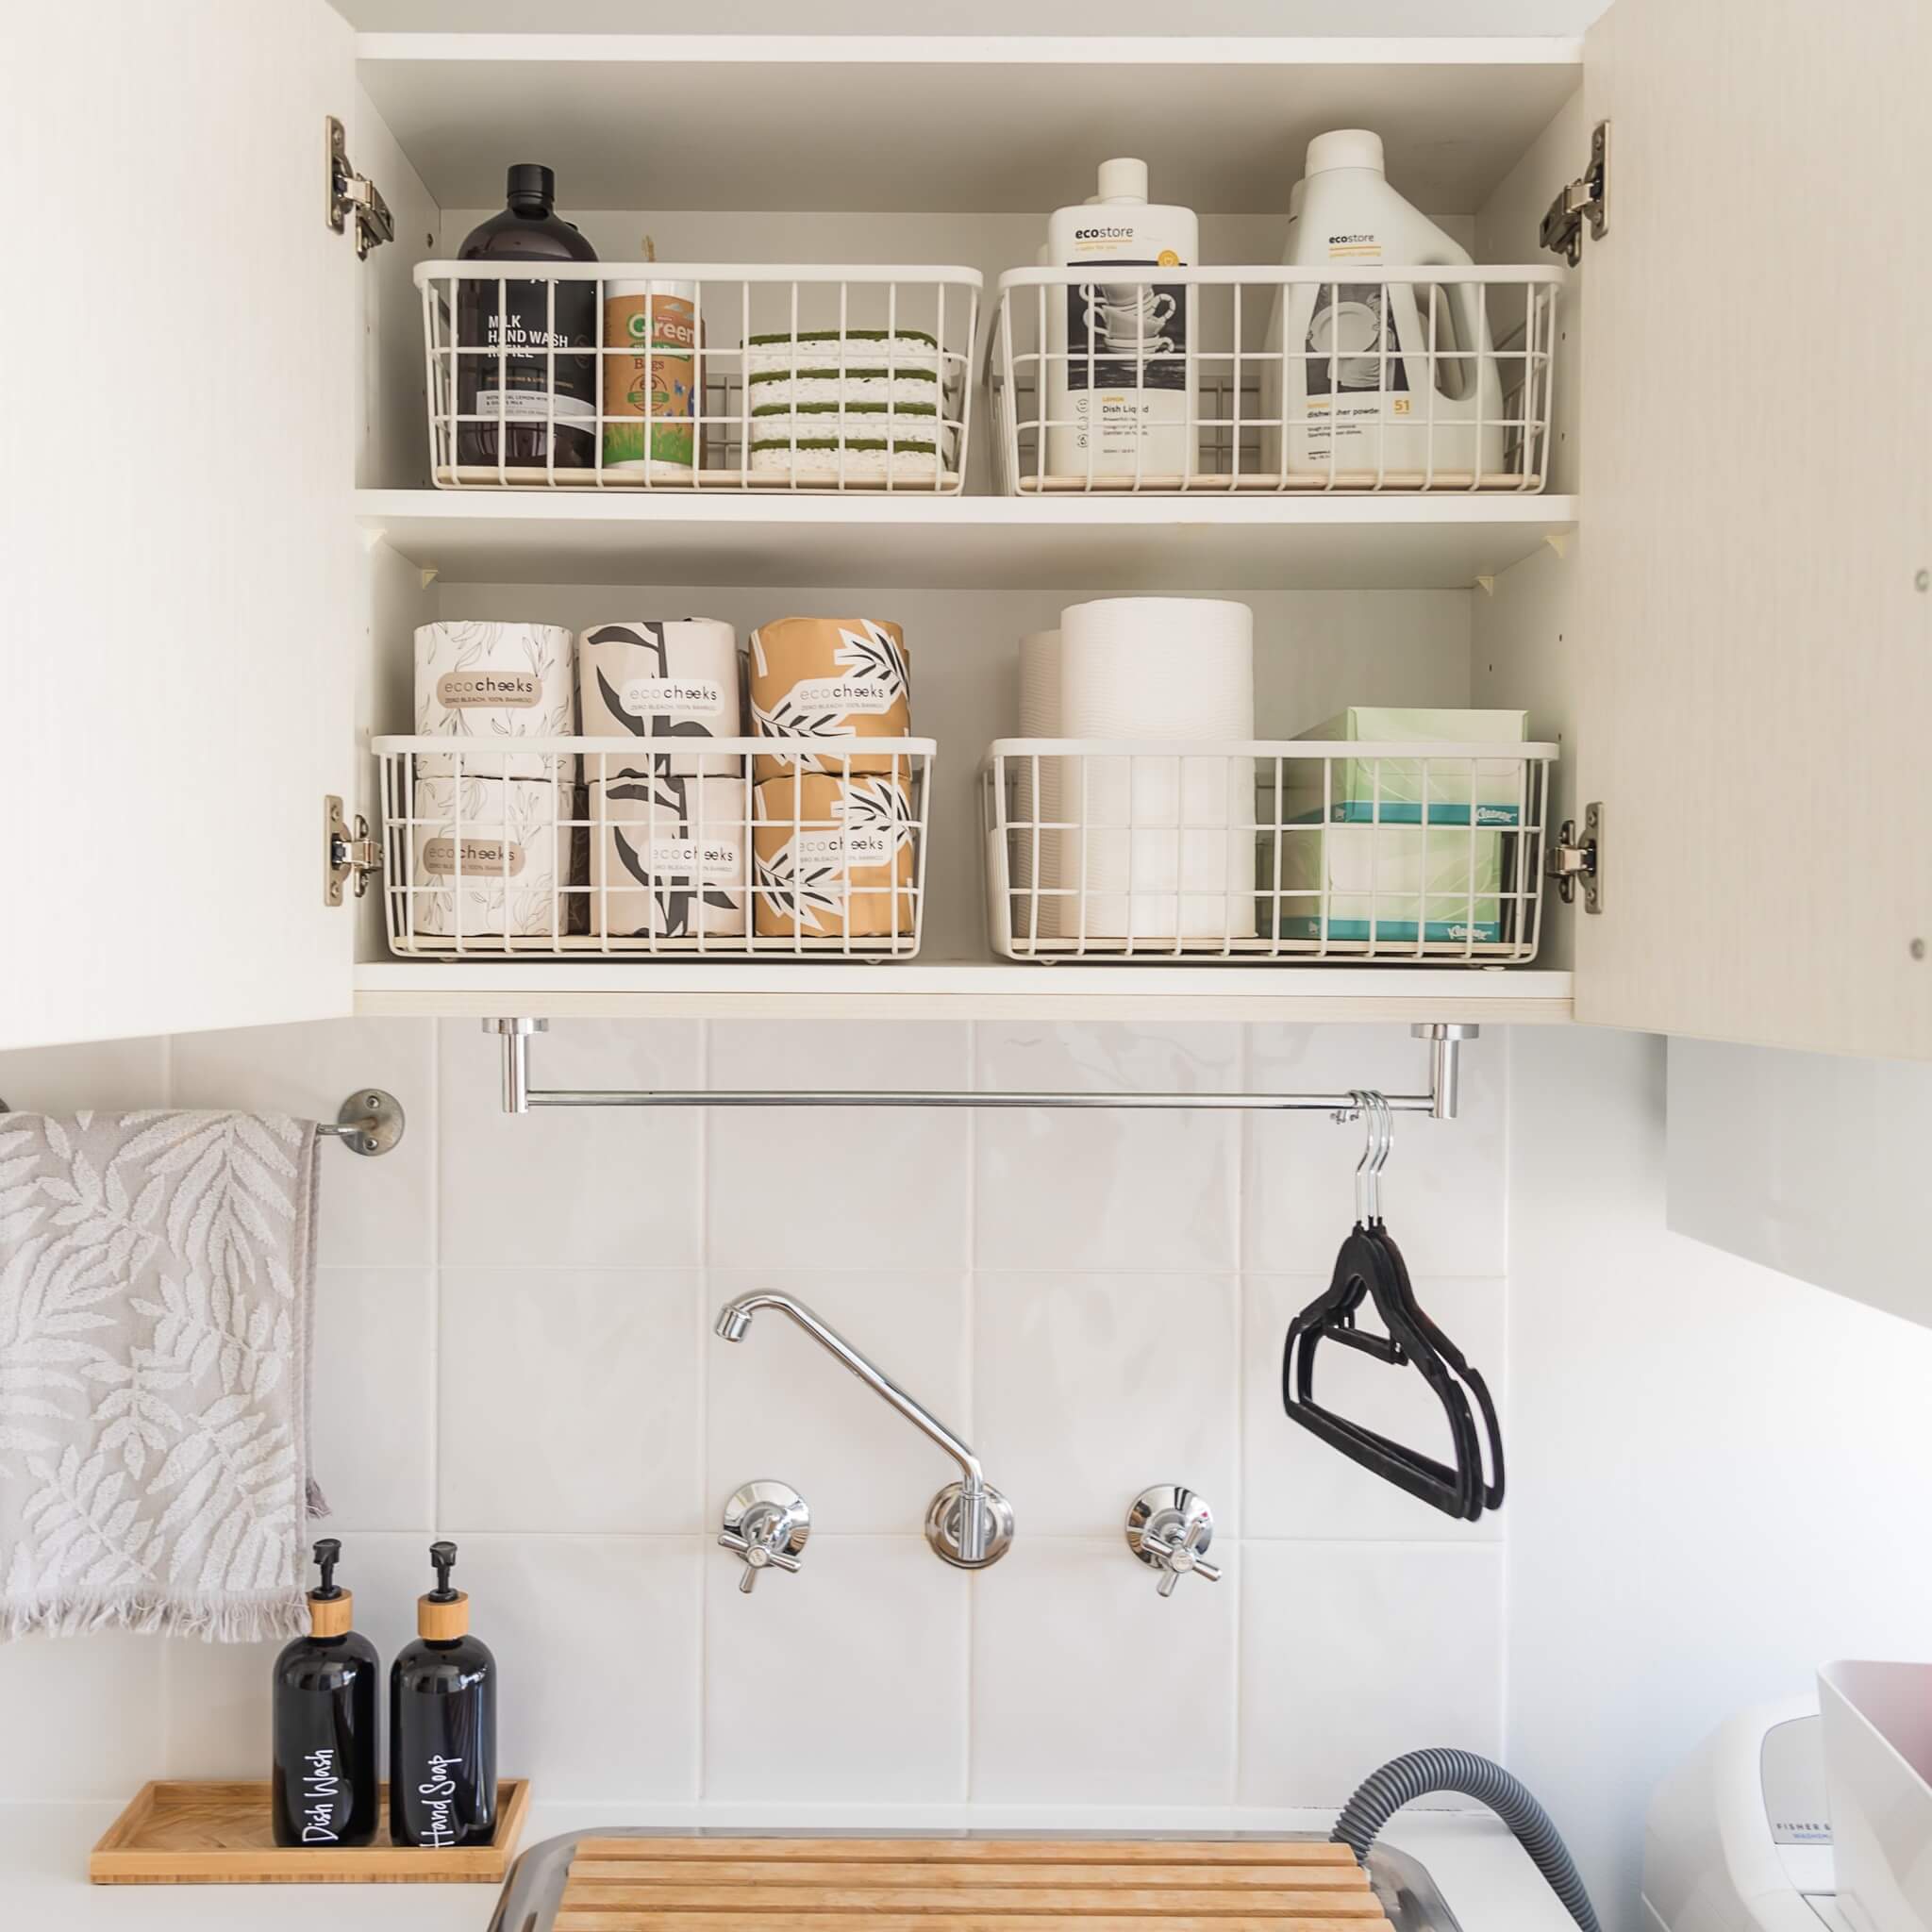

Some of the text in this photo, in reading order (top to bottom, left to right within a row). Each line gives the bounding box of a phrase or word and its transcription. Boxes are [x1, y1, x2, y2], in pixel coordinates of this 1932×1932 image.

[1075, 227, 1134, 239] ecostore
[1329, 235, 1374, 243] ecostore
[489, 315, 521, 328] MLK
[489, 330, 568, 347] HND WASH
[634, 358, 666, 371] Bgs
[1124, 406, 1148, 414] Liqid
[1394, 400, 1409, 410] 51
[445, 677, 533, 692] ecocheeks
[630, 685, 717, 700] ecocheeks
[800, 684, 884, 700] ecocheeks
[302, 1749, 339, 1841] Dish Wash
[418, 1755, 463, 1847] Hand Soap
